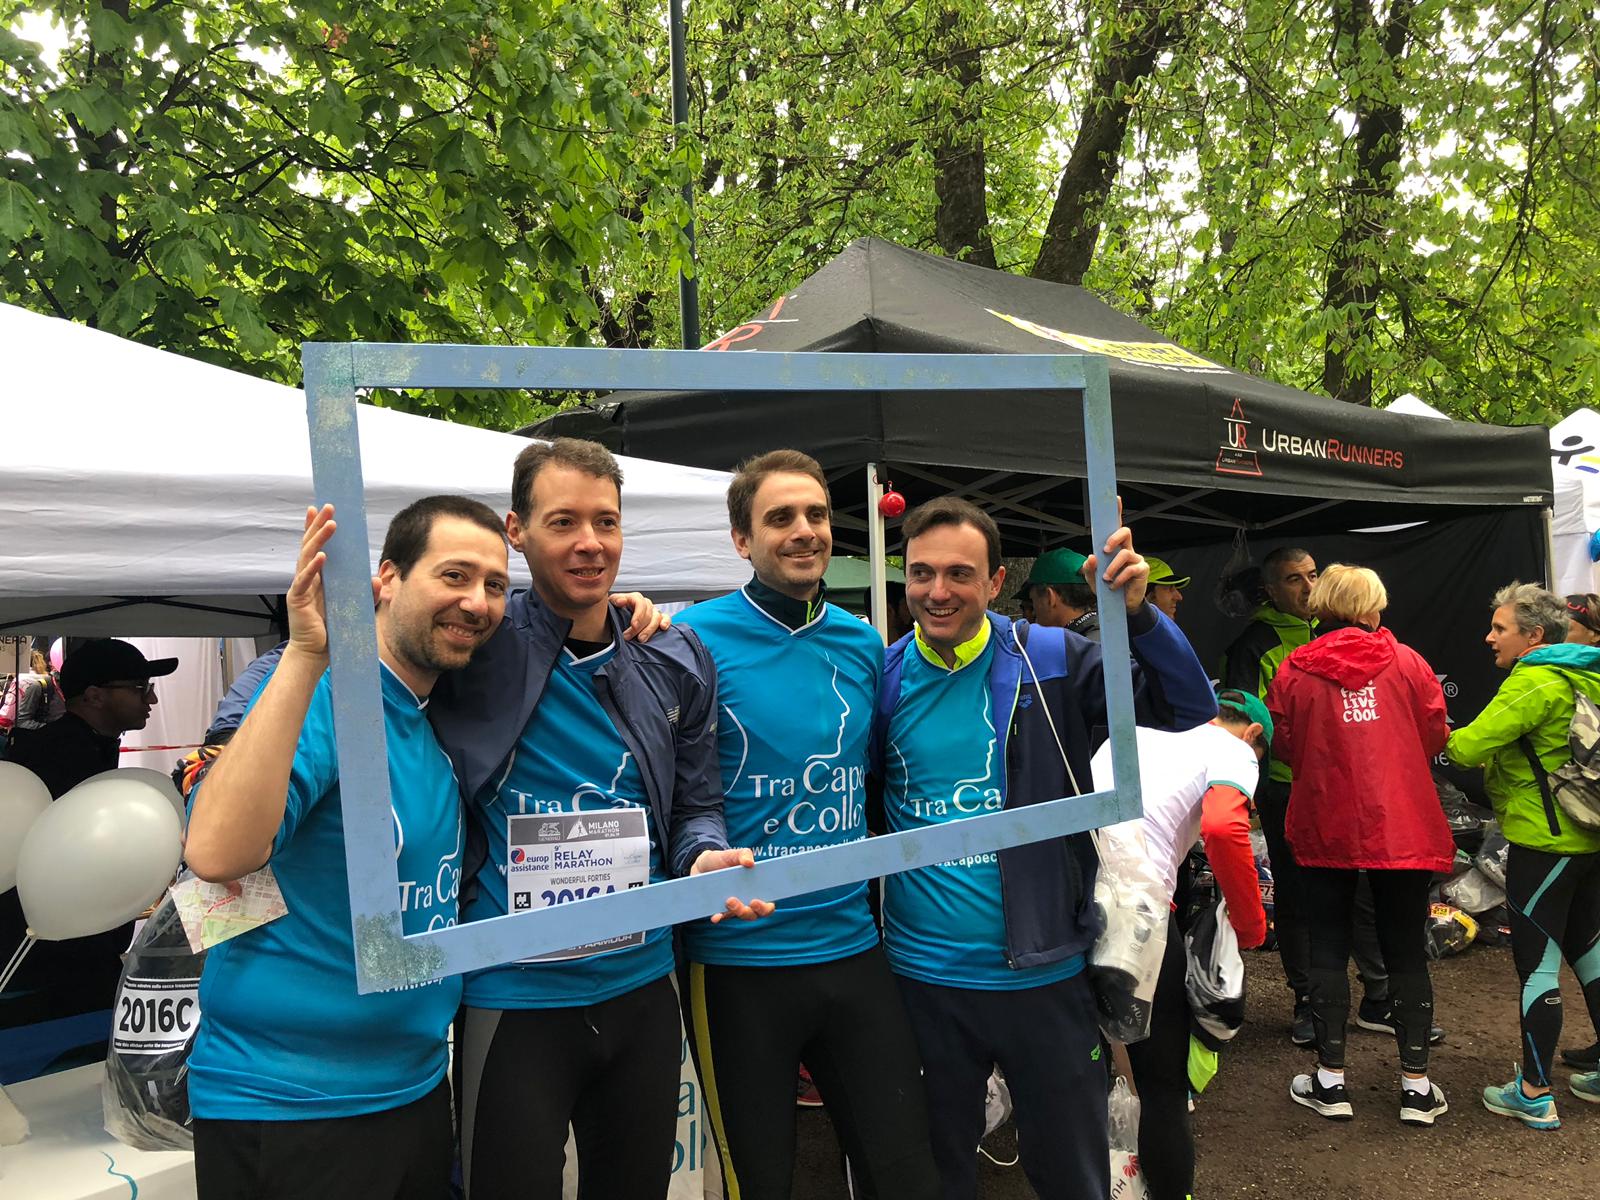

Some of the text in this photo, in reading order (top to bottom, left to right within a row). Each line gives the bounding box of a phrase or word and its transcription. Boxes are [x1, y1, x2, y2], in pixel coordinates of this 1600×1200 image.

[1343, 696, 1378, 710] LIVE
[1343, 708, 1380, 723] COOL
[748, 761, 865, 798] Tra Capo
[510, 789, 564, 814] Tra
[910, 784, 1002, 817] Tra Ca
[763, 794, 863, 835] e Collo
[588, 820, 620, 830] MILANO
[526, 854, 550, 863] europ
[554, 849, 594, 861] RELAY
[510, 863, 550, 873] assistance
[554, 857, 613, 870] MARATHON
[550, 873, 611, 886] WONDERFUL FORTIES
[398, 881, 432, 912] Tra
[119, 996, 194, 1033] 2016C
